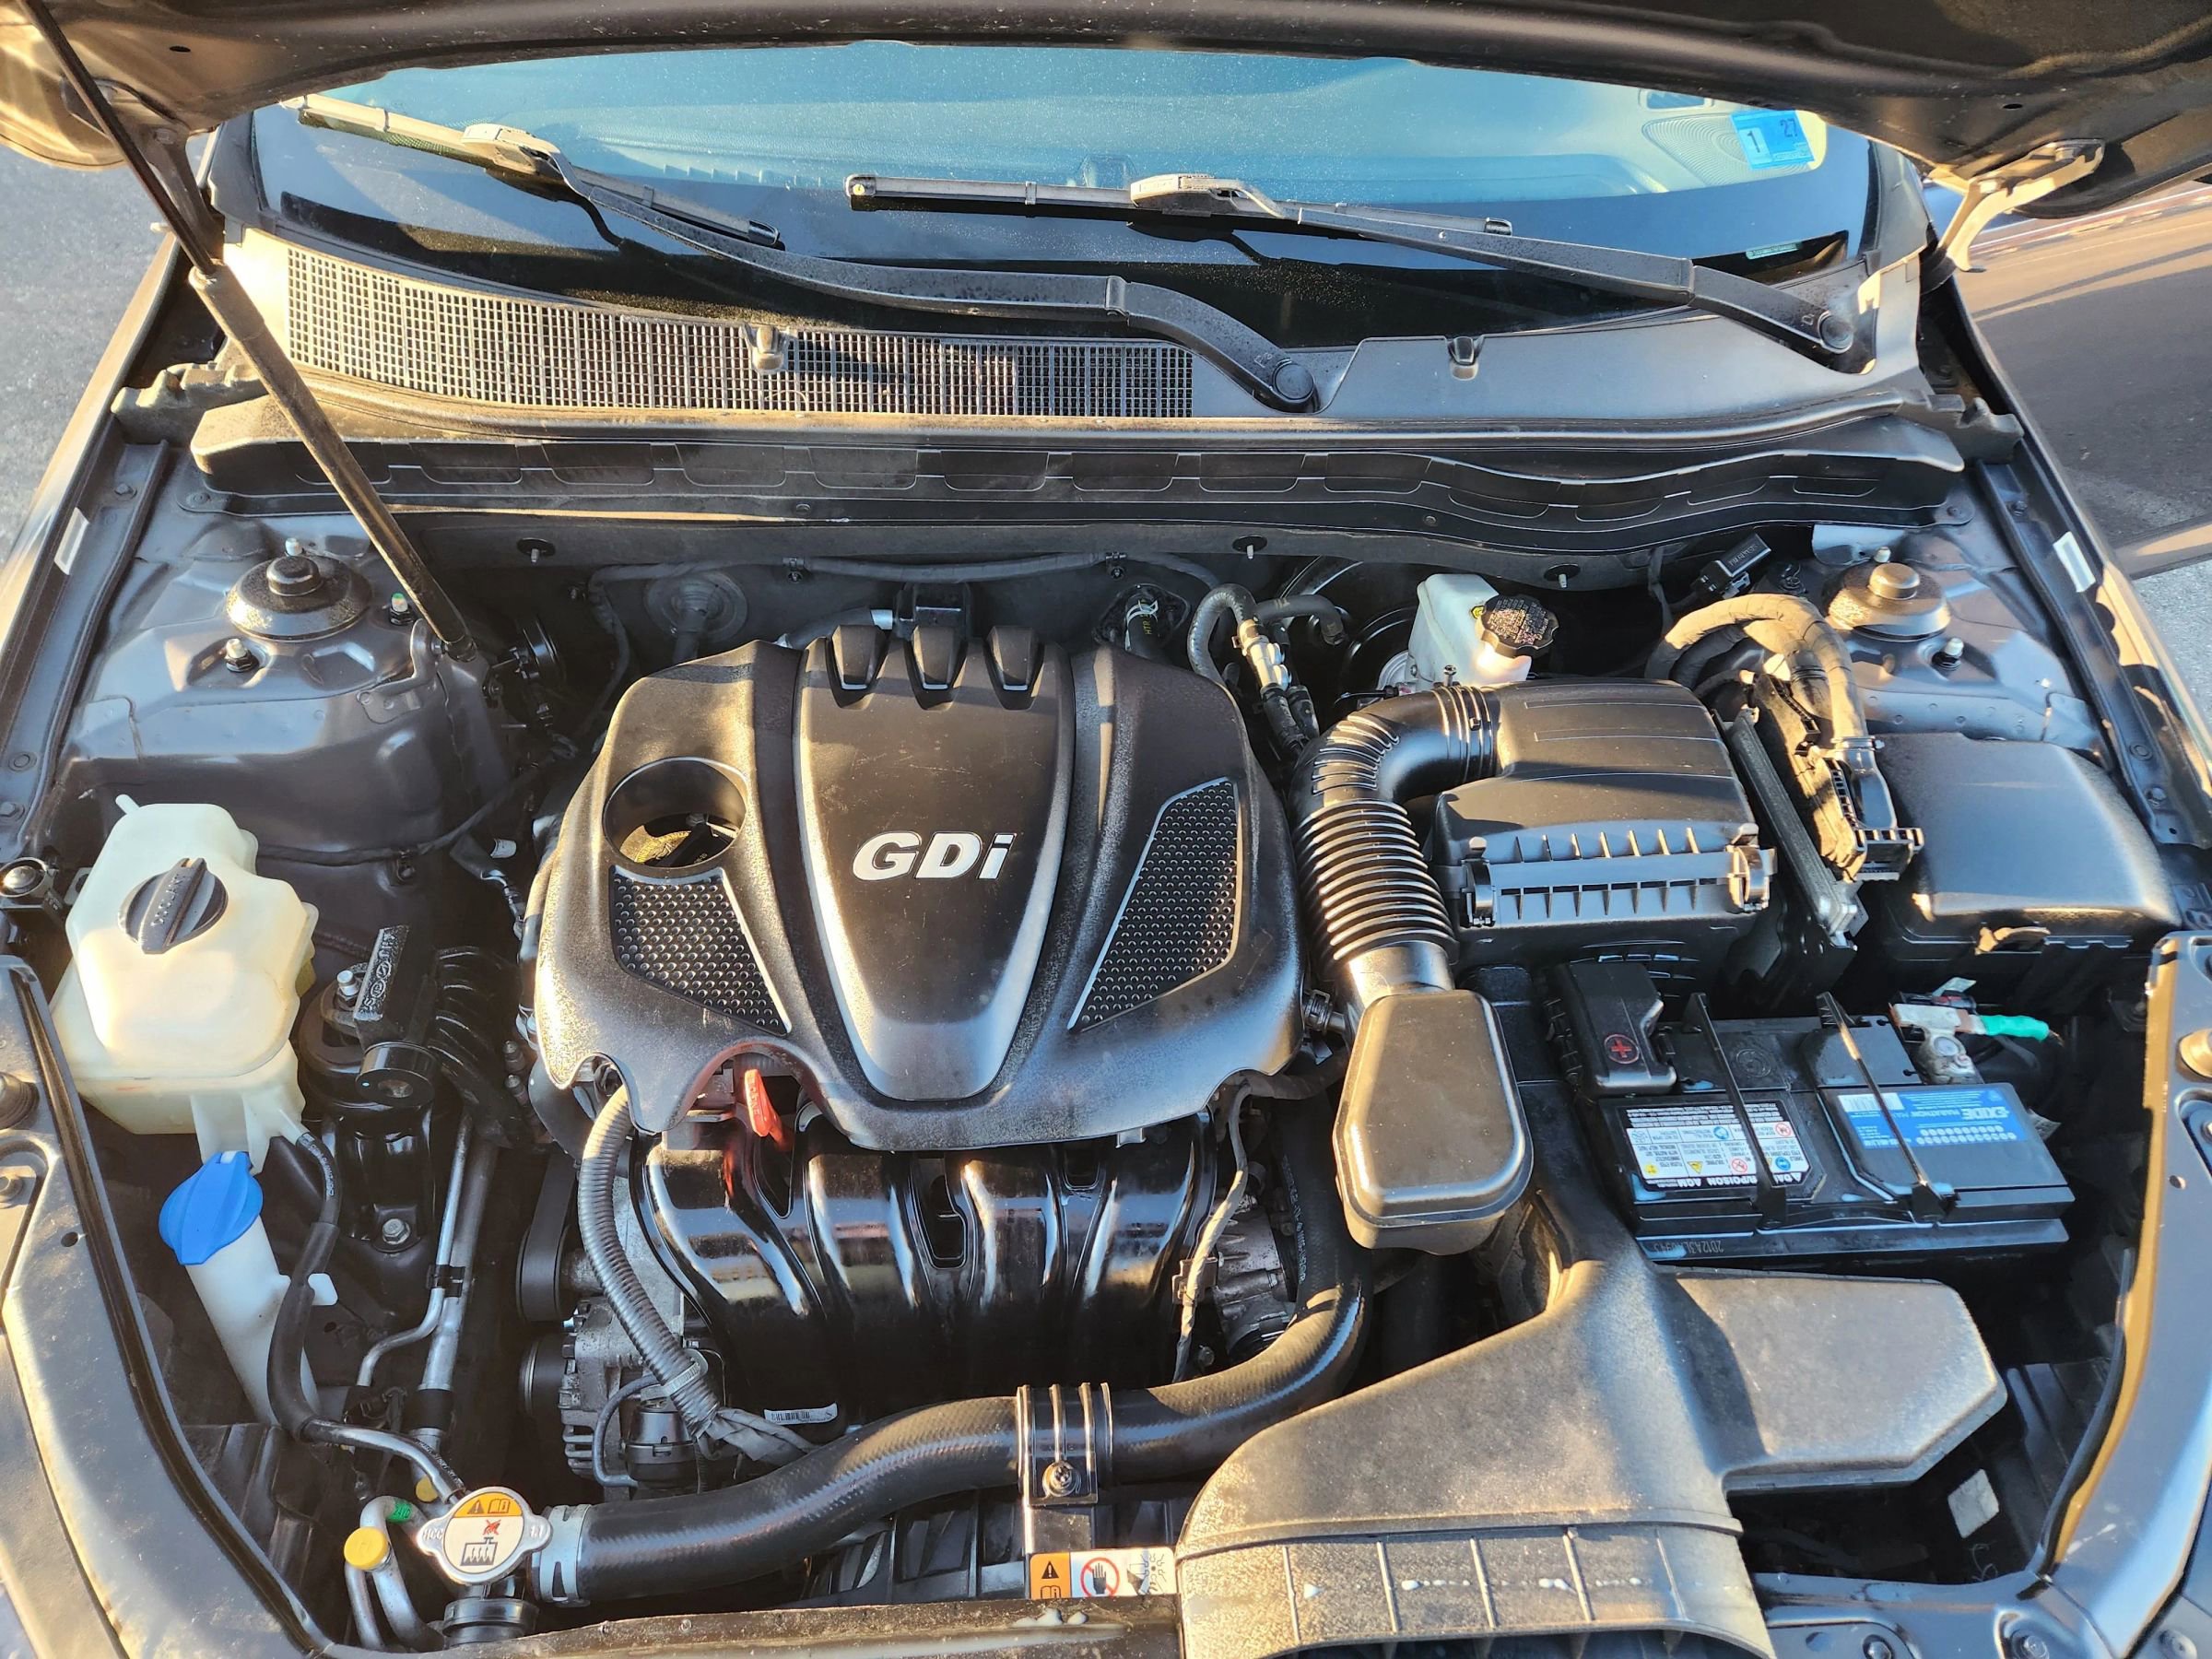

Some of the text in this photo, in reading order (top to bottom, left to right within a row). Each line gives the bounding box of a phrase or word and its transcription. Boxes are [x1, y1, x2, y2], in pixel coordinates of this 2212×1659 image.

[1780, 118, 1798, 138] 27
[1747, 130, 1760, 153] 1
[852, 830, 1018, 881] GDi
[1960, 1106, 2008, 1120] EXIDE
